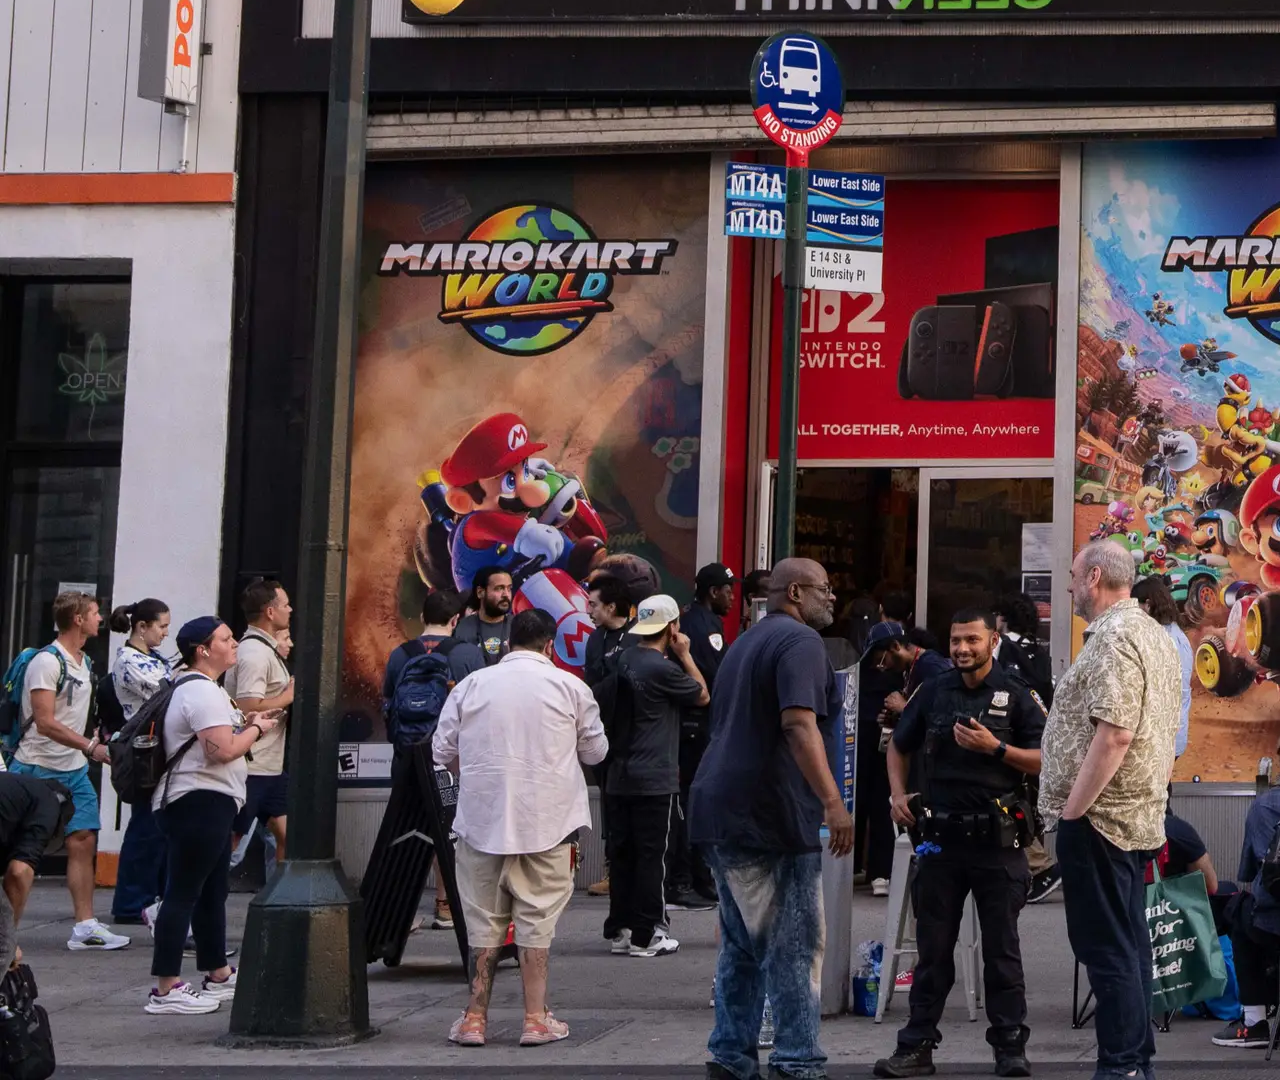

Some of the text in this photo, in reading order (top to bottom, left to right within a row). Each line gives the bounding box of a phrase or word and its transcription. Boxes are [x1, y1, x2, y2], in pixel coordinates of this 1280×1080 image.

[762, 111, 837, 147] NO STANDING
[731, 171, 782, 199] M14A
[812, 174, 881, 192] Lower East Side
[730, 208, 782, 235] M14D
[811, 210, 879, 228] Lower East Side
[810, 250, 851, 265] E 14 St &
[810, 266, 854, 283] University
[444, 272, 608, 311] WORLD
[805, 341, 882, 351] INTENDO
[67, 373, 121, 389] OPEN
[821, 424, 904, 437] TOGETHER,
[907, 424, 968, 438] Anytime,
[972, 423, 1040, 436] Anywhere
[338, 752, 356, 772] E
[1145, 899, 1180, 920] ank
[1152, 936, 1198, 960] pping
